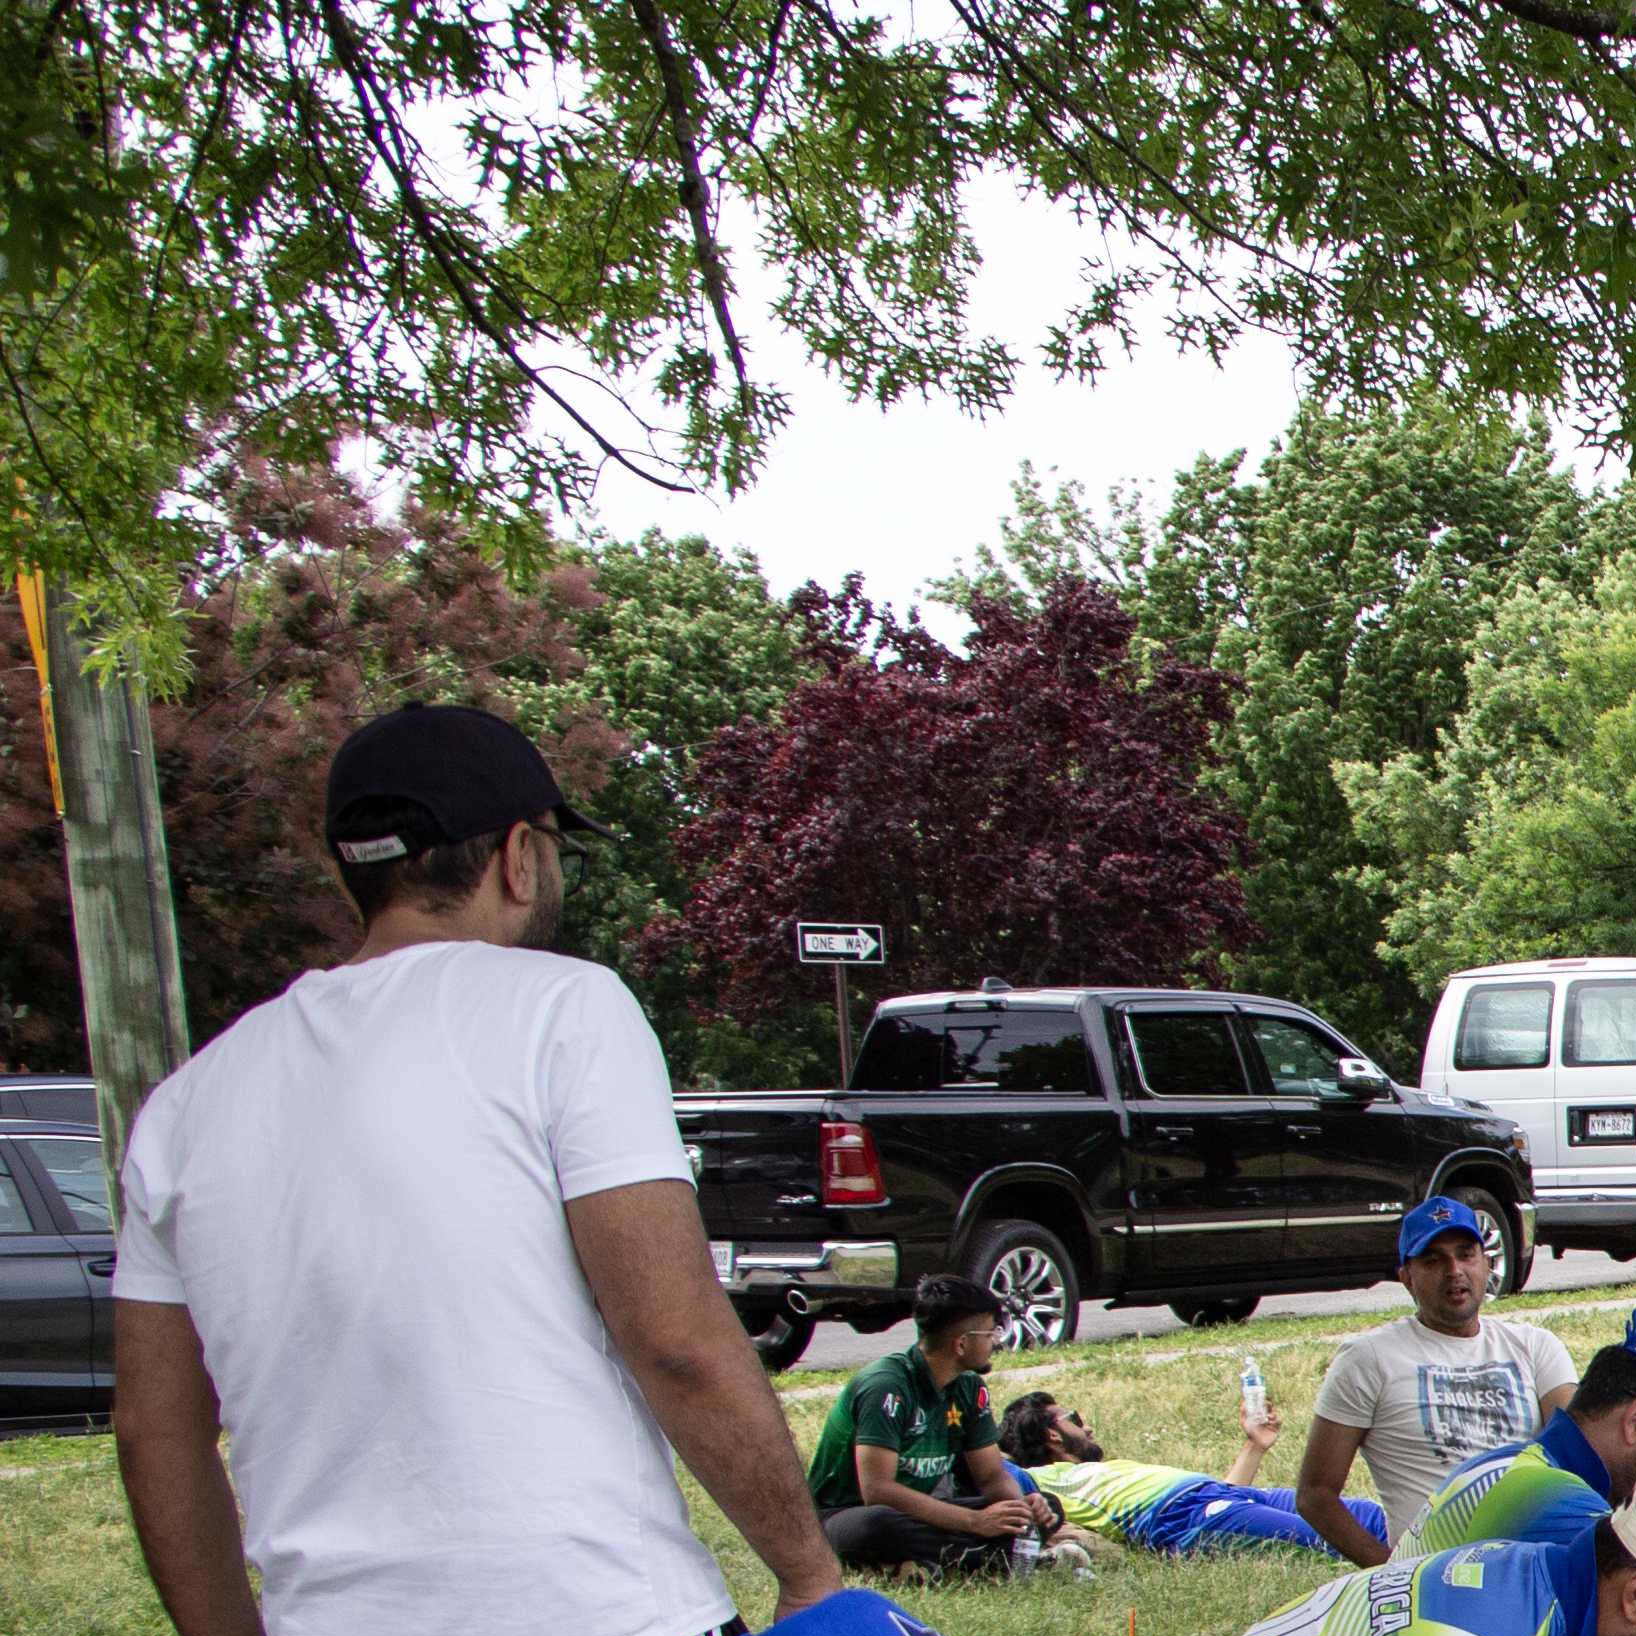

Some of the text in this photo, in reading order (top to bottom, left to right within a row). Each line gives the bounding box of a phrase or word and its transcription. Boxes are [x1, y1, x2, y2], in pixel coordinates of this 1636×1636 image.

[811, 936, 869, 951] ONE WAY
[1433, 1387, 1508, 1408] ENDLESS
